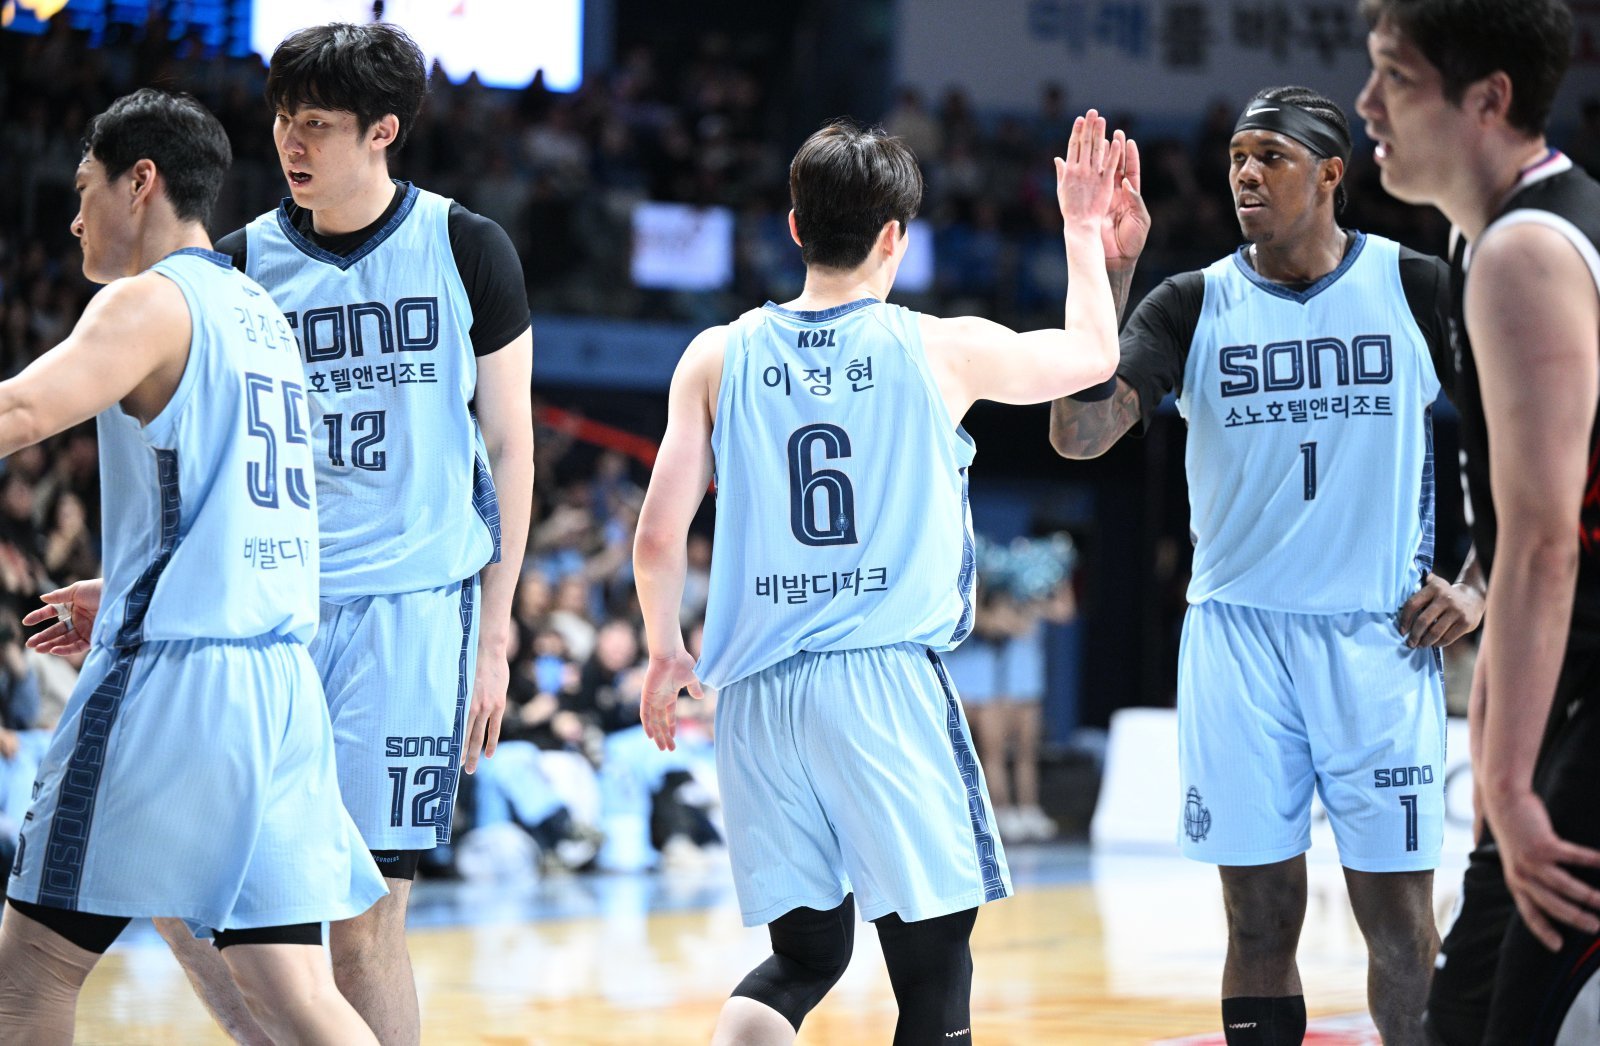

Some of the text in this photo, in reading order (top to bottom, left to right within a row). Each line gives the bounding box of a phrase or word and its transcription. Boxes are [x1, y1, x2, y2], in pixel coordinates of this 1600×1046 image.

[797, 328, 836, 348] KBL
[762, 355, 875, 396] 이정현
[244, 371, 311, 510] 55
[323, 410, 387, 471] 12
[1224, 394, 1393, 428] 소노호텔앤리조트
[786, 422, 859, 547] 6
[1299, 441, 1318, 501] 1
[755, 567, 889, 605] 비발디파크
[387, 765, 449, 828] 12
[1398, 794, 1419, 852] 1
